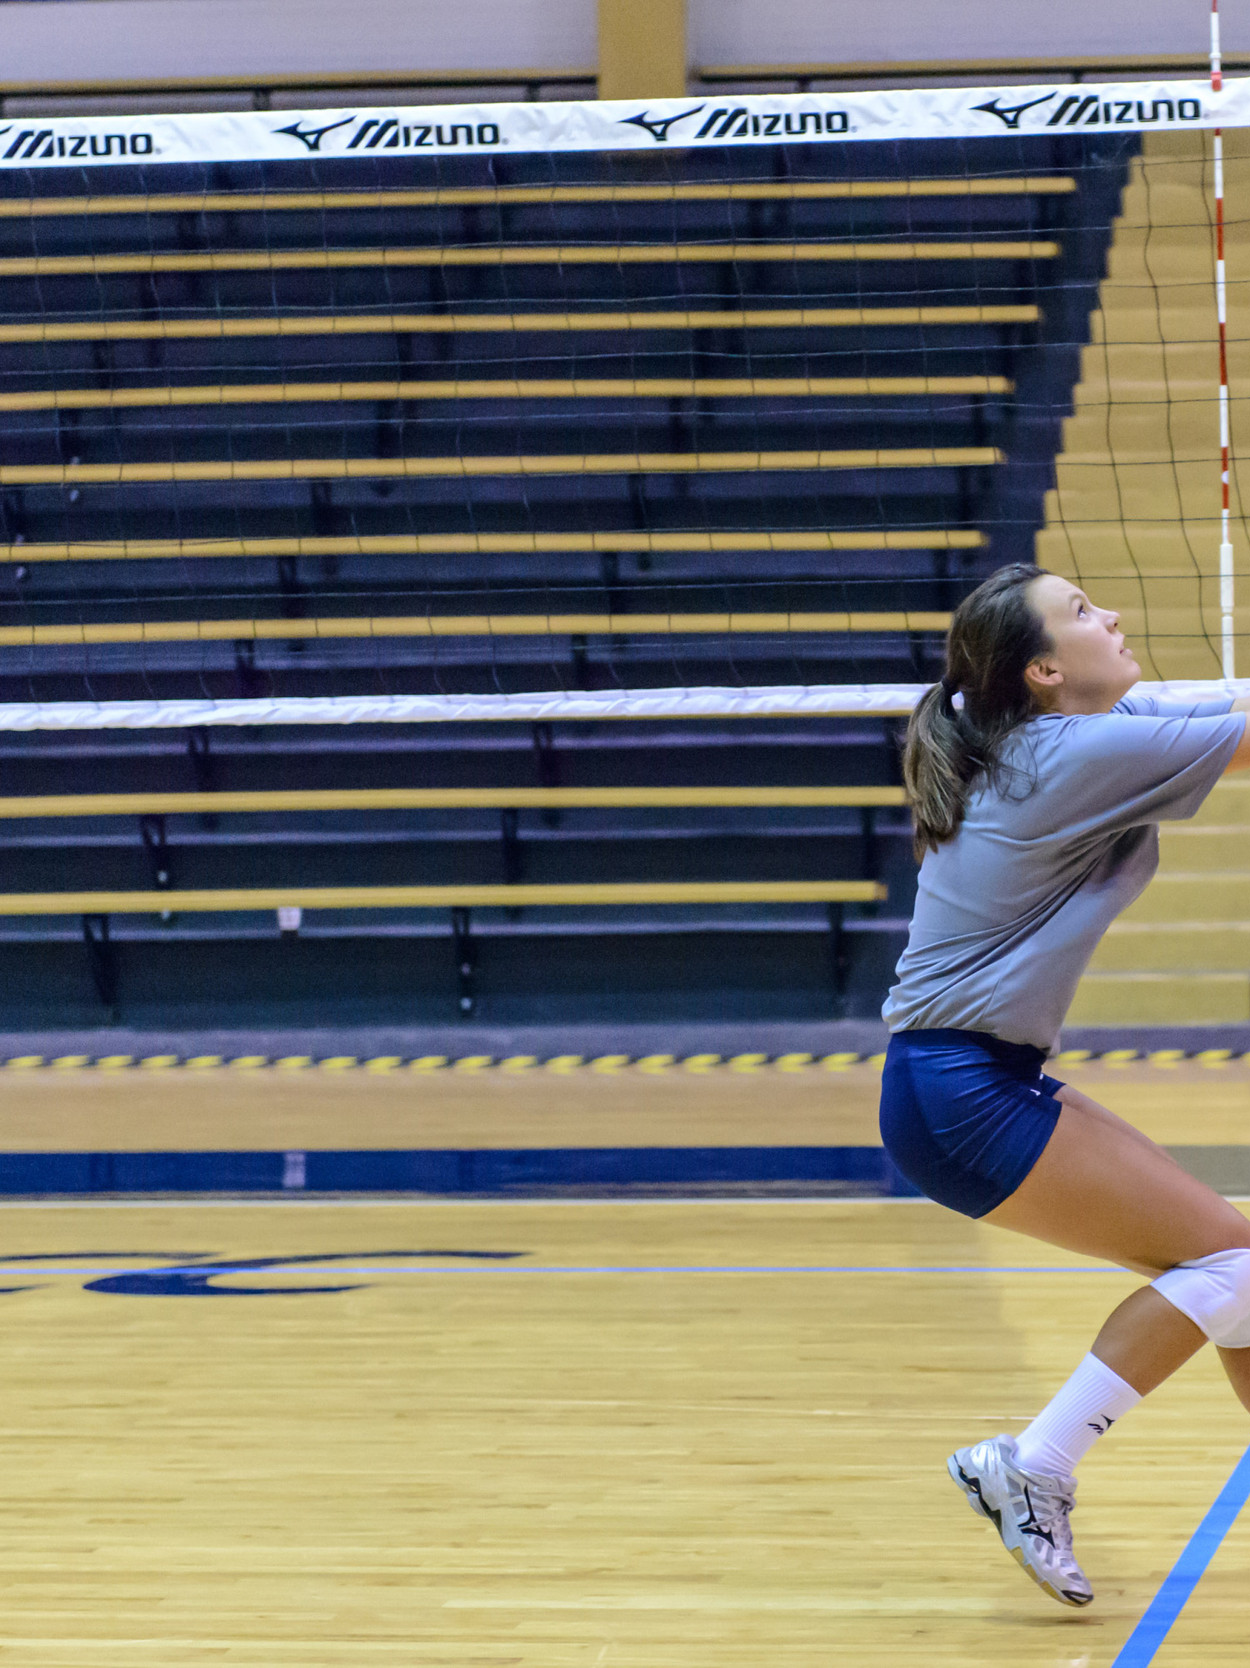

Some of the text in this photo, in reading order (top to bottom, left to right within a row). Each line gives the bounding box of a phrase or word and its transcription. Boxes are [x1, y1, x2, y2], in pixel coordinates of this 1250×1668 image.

[694, 107, 849, 139] MIZUNO
[1046, 95, 1200, 126] MIZUNO
[2, 129, 154, 159] MIZUNO
[346, 118, 500, 149] MIZUNO
